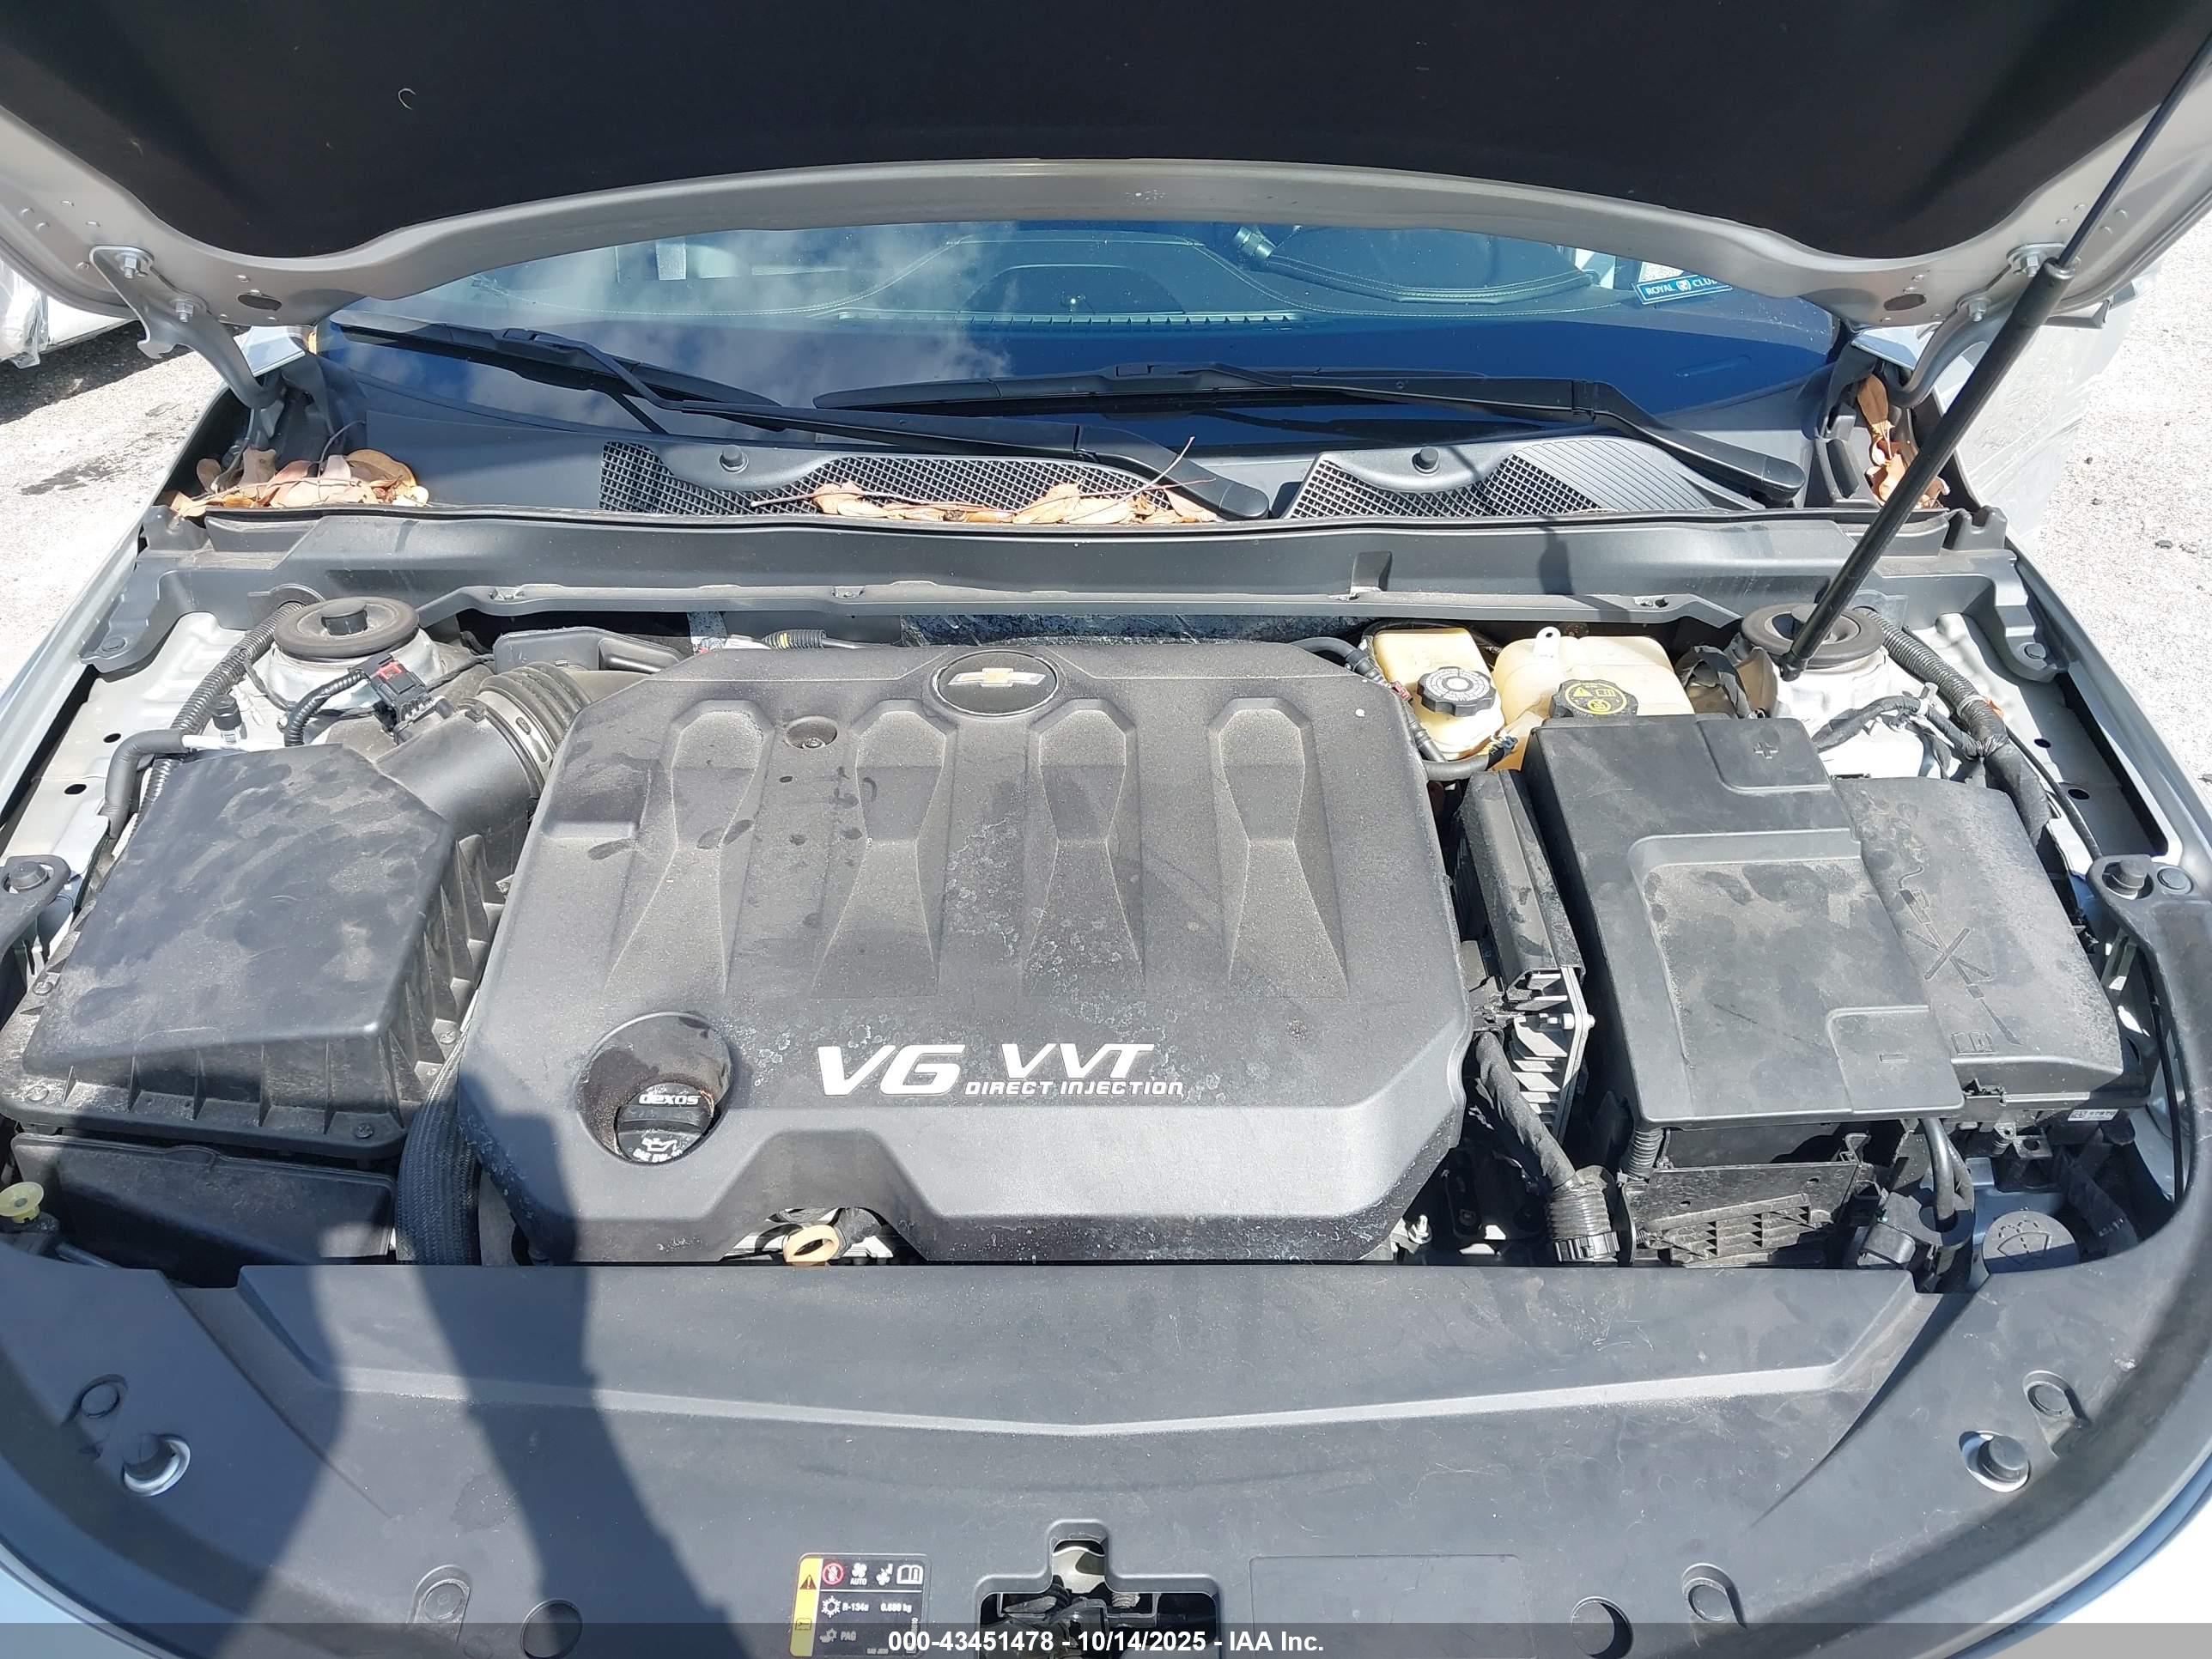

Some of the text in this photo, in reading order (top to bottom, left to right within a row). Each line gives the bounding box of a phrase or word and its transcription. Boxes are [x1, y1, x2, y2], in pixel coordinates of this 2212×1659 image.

[1644, 283, 1676, 295] ROYAL
[817, 1043, 1155, 1096] V6 VVT
[965, 1081, 1183, 1096] DIRECT INJECTION
[842, 1602, 868, 1611] R-134a
[902, 1603, 912, 1613] kg
[840, 1631, 856, 1641] PAG
